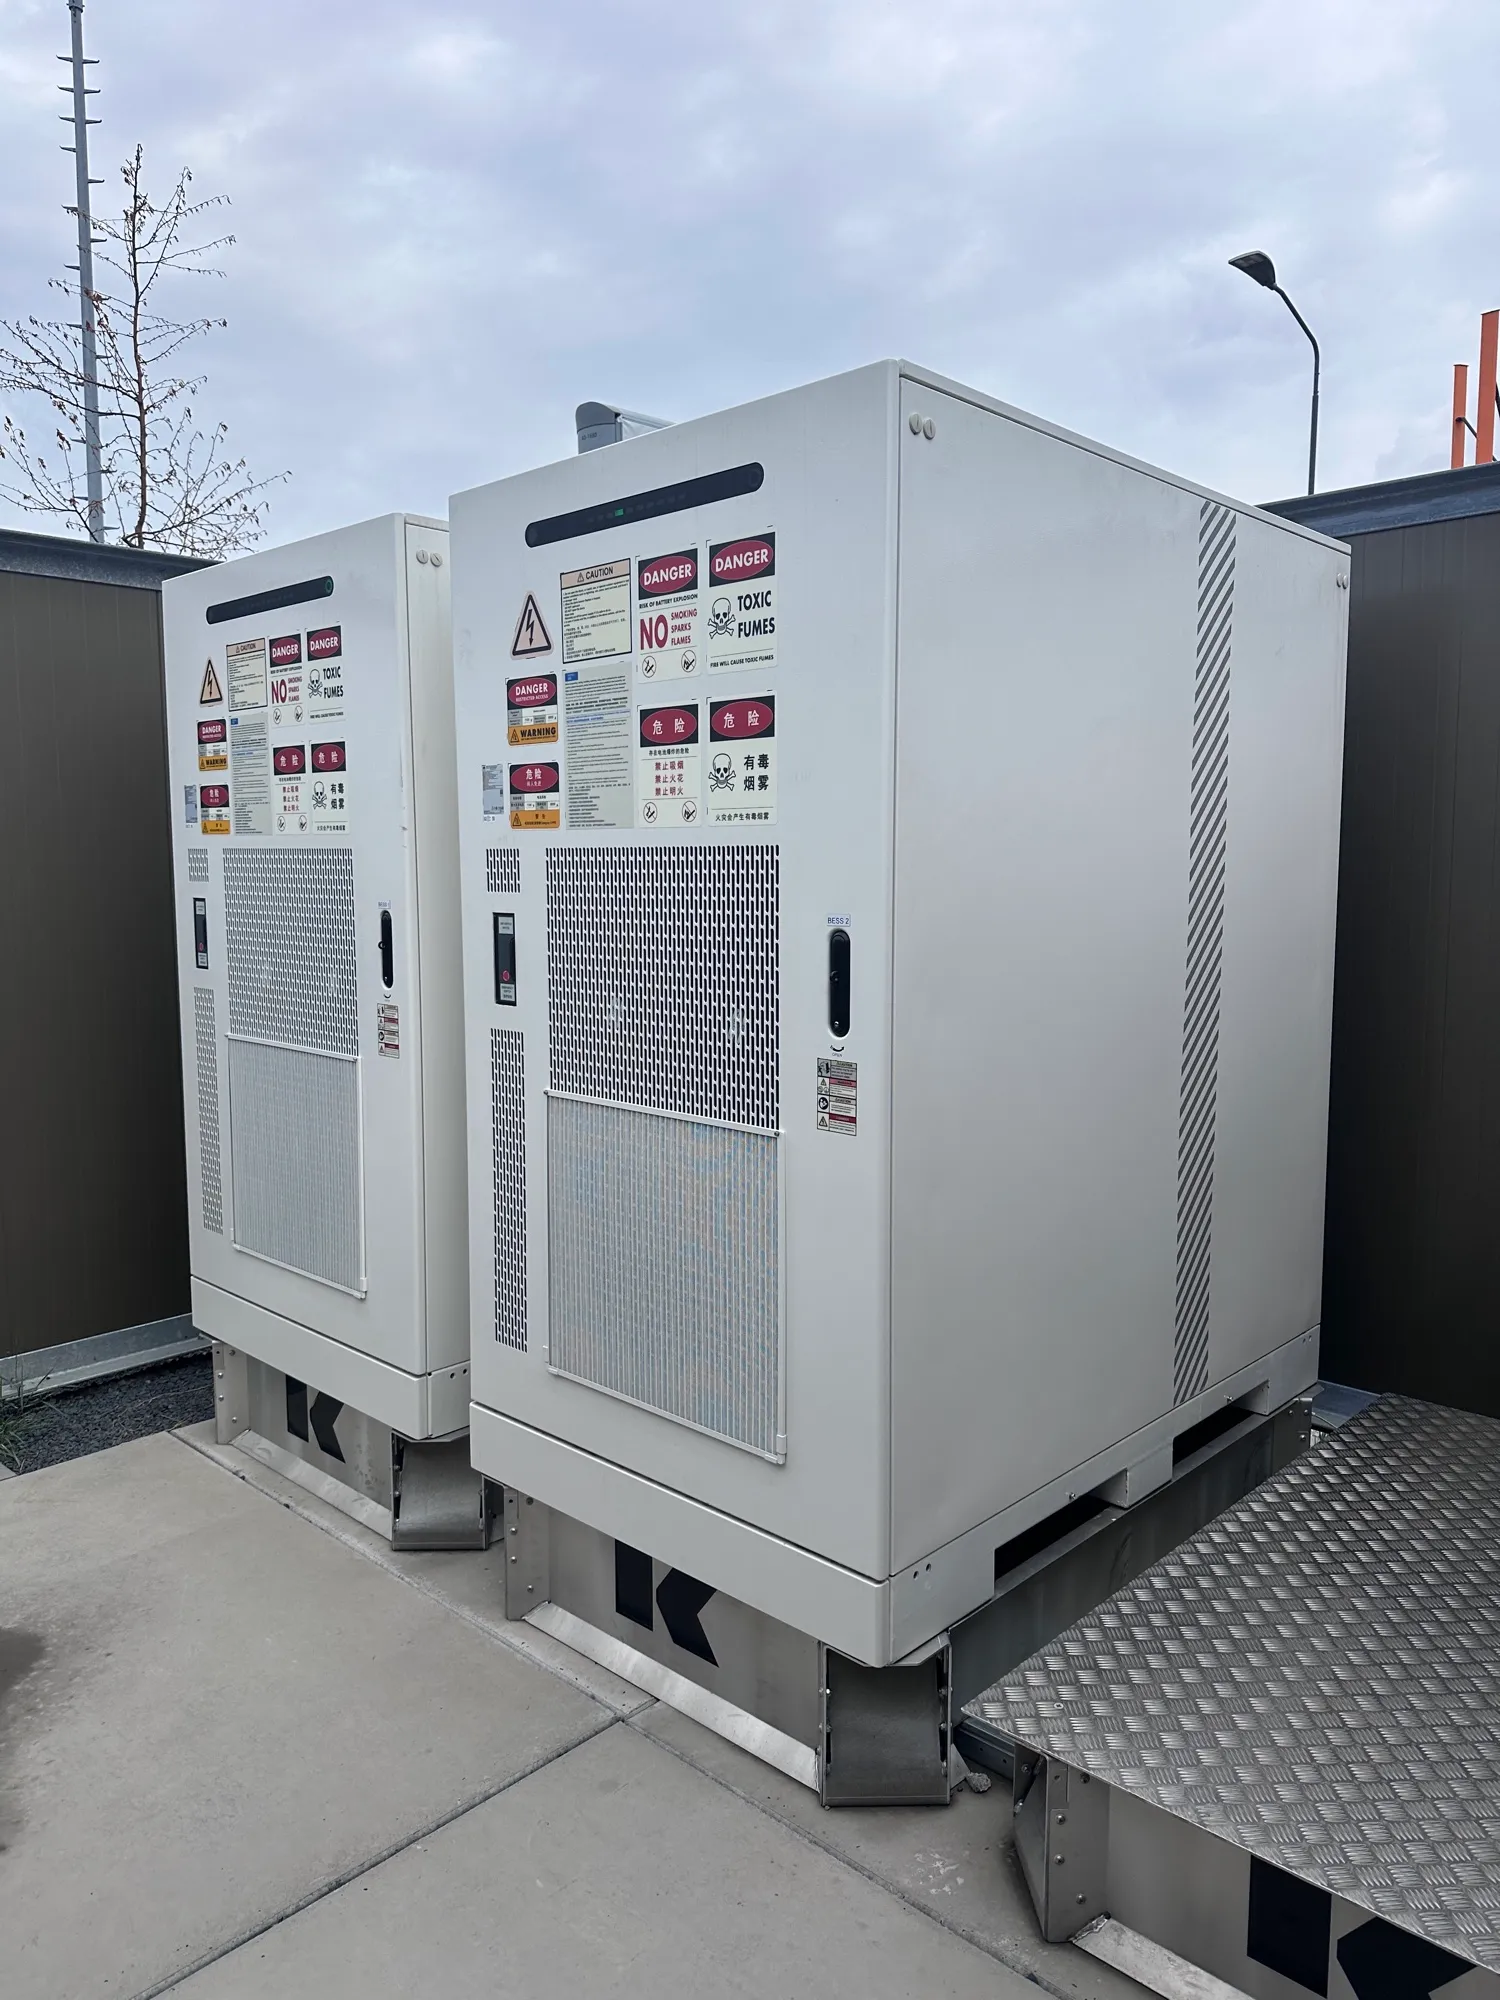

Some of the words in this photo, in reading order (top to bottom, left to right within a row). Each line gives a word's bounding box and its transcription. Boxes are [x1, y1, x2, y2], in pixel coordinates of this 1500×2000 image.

[715, 548, 769, 572] DANGER
[585, 566, 614, 580] CAUTION
[643, 563, 692, 586] DANGER
[655, 598, 673, 607] BATTERY
[673, 593, 698, 603] EXPLOSION
[737, 590, 772, 612] TOXIC
[671, 608, 698, 620] SMOKING
[640, 614, 669, 650] NO
[671, 622, 692, 633] SPARKS
[738, 617, 776, 638] FUMES
[310, 636, 339, 651] DANGER
[671, 635, 691, 646] FLAMES
[272, 644, 299, 658] DANGER
[744, 656, 758, 664] TOXIC
[758, 654, 774, 662] FUMES
[322, 665, 341, 680] TOXIC
[271, 678, 287, 704] NO
[323, 685, 344, 699] FUMES
[515, 682, 549, 696] DANGER
[723, 709, 760, 728] 危险
[202, 725, 222, 735] DANGER
[520, 727, 556, 738] WARNING
[652, 717, 685, 735] 危险
[655, 760, 684, 771] 禁止吸烟
[743, 753, 770, 770] 有毒
[525, 768, 542, 780] 危险
[655, 773, 684, 784] 禁止火花
[743, 774, 769, 791] 烟雾
[655, 786, 684, 797] 禁止明火
[827, 916, 845, 925] BESS
[845, 917, 850, 925] 2
